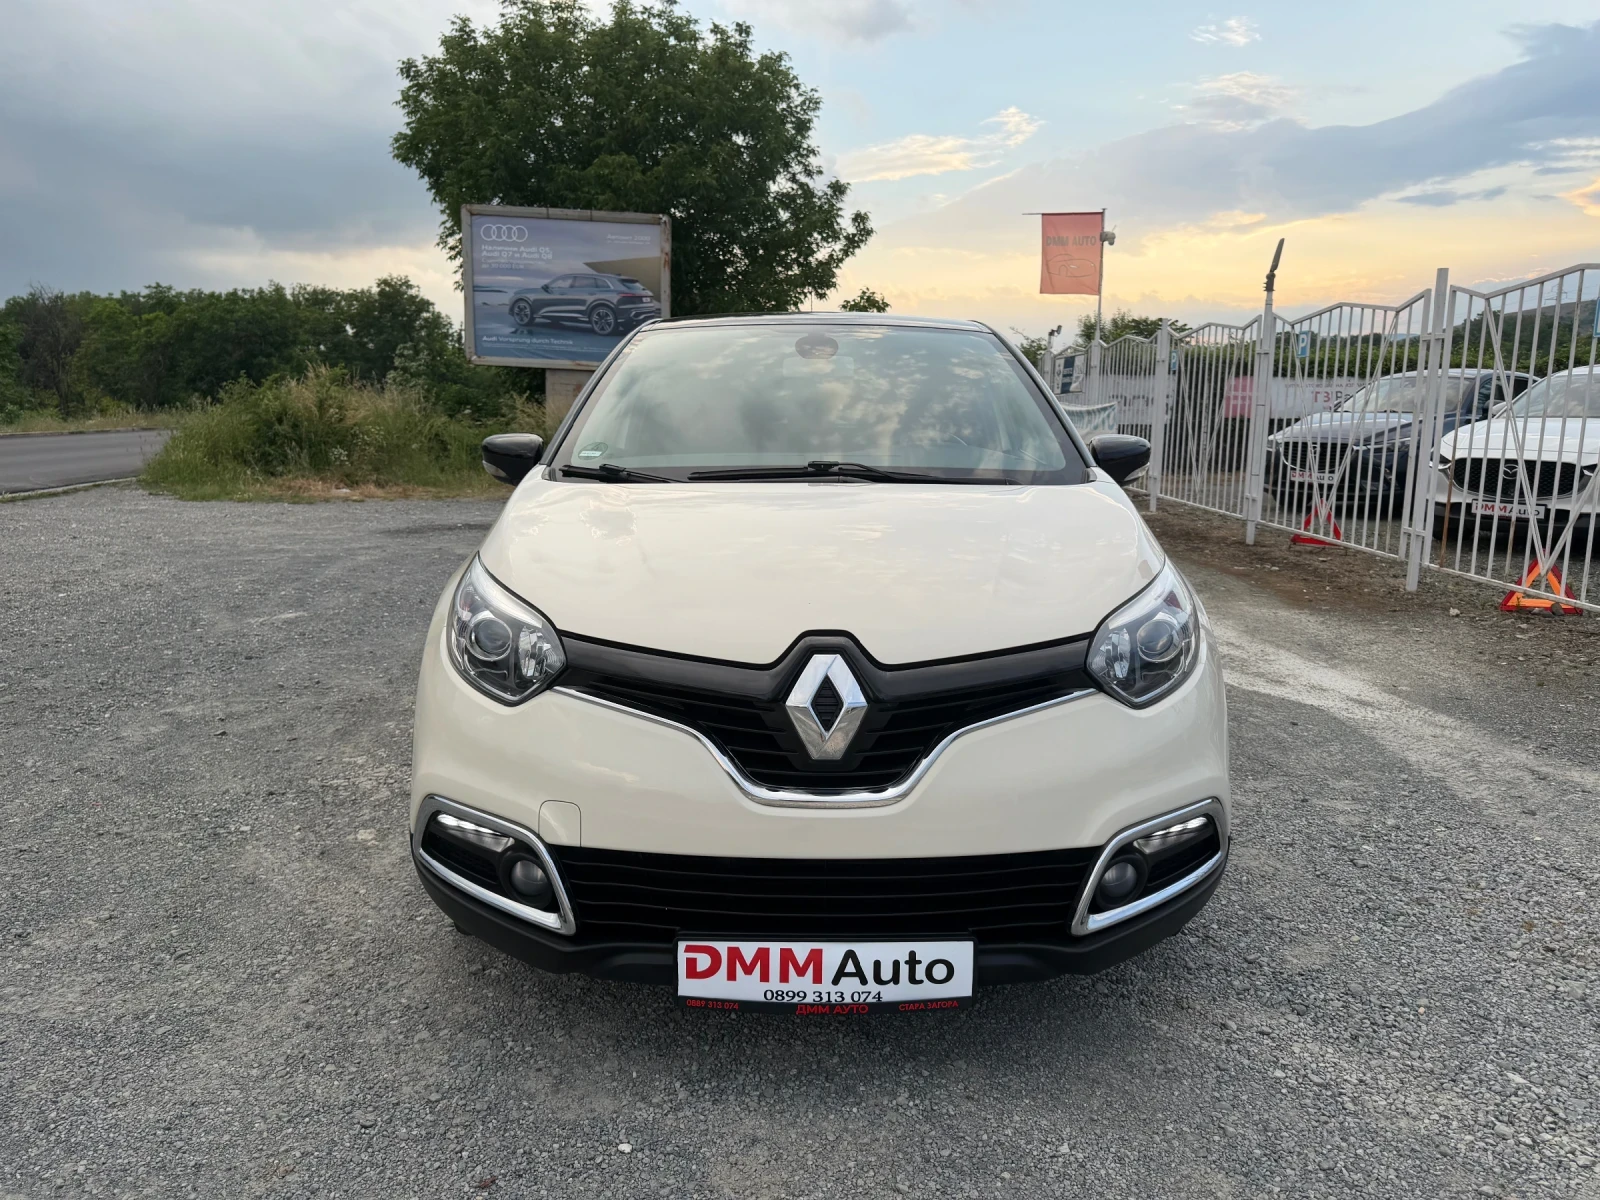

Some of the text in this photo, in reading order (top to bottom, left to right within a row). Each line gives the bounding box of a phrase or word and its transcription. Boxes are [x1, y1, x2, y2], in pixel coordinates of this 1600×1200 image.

[1046, 235, 1096, 246] DMM AUTO
[498, 336, 531, 344] Vorsprung
[1299, 334, 1307, 354] P
[684, 944, 955, 986] DMM Auto
[763, 989, 883, 1003] 0899 313 074
[707, 1001, 722, 1009] 313
[723, 1002, 739, 1010] 074
[796, 1004, 869, 1015] ДММ АУТО
[898, 1000, 959, 1011] СТАРА ЗАГОРА
